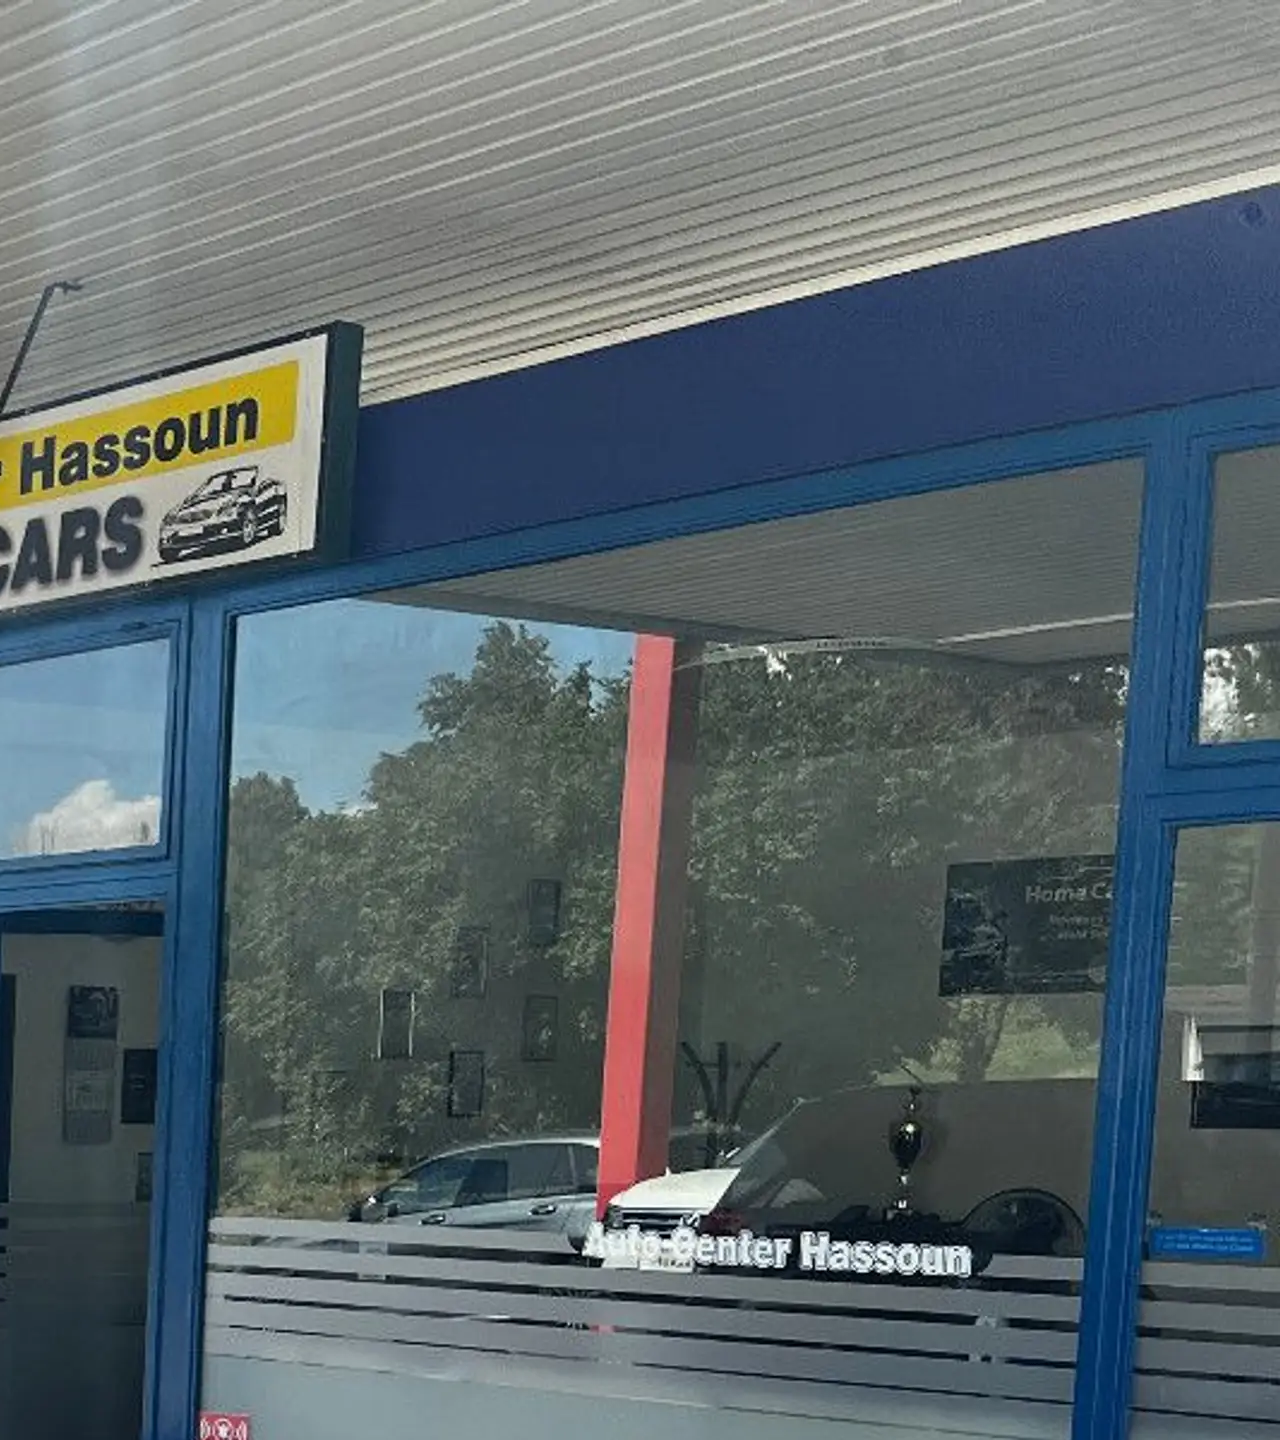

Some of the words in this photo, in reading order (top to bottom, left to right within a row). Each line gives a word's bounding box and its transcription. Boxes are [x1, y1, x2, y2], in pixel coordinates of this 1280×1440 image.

[19, 397, 258, 495] Hassoun
[582, 1221, 661, 1259] Auto
[671, 1226, 791, 1269] Center
[799, 1230, 973, 1277] Hassoun
